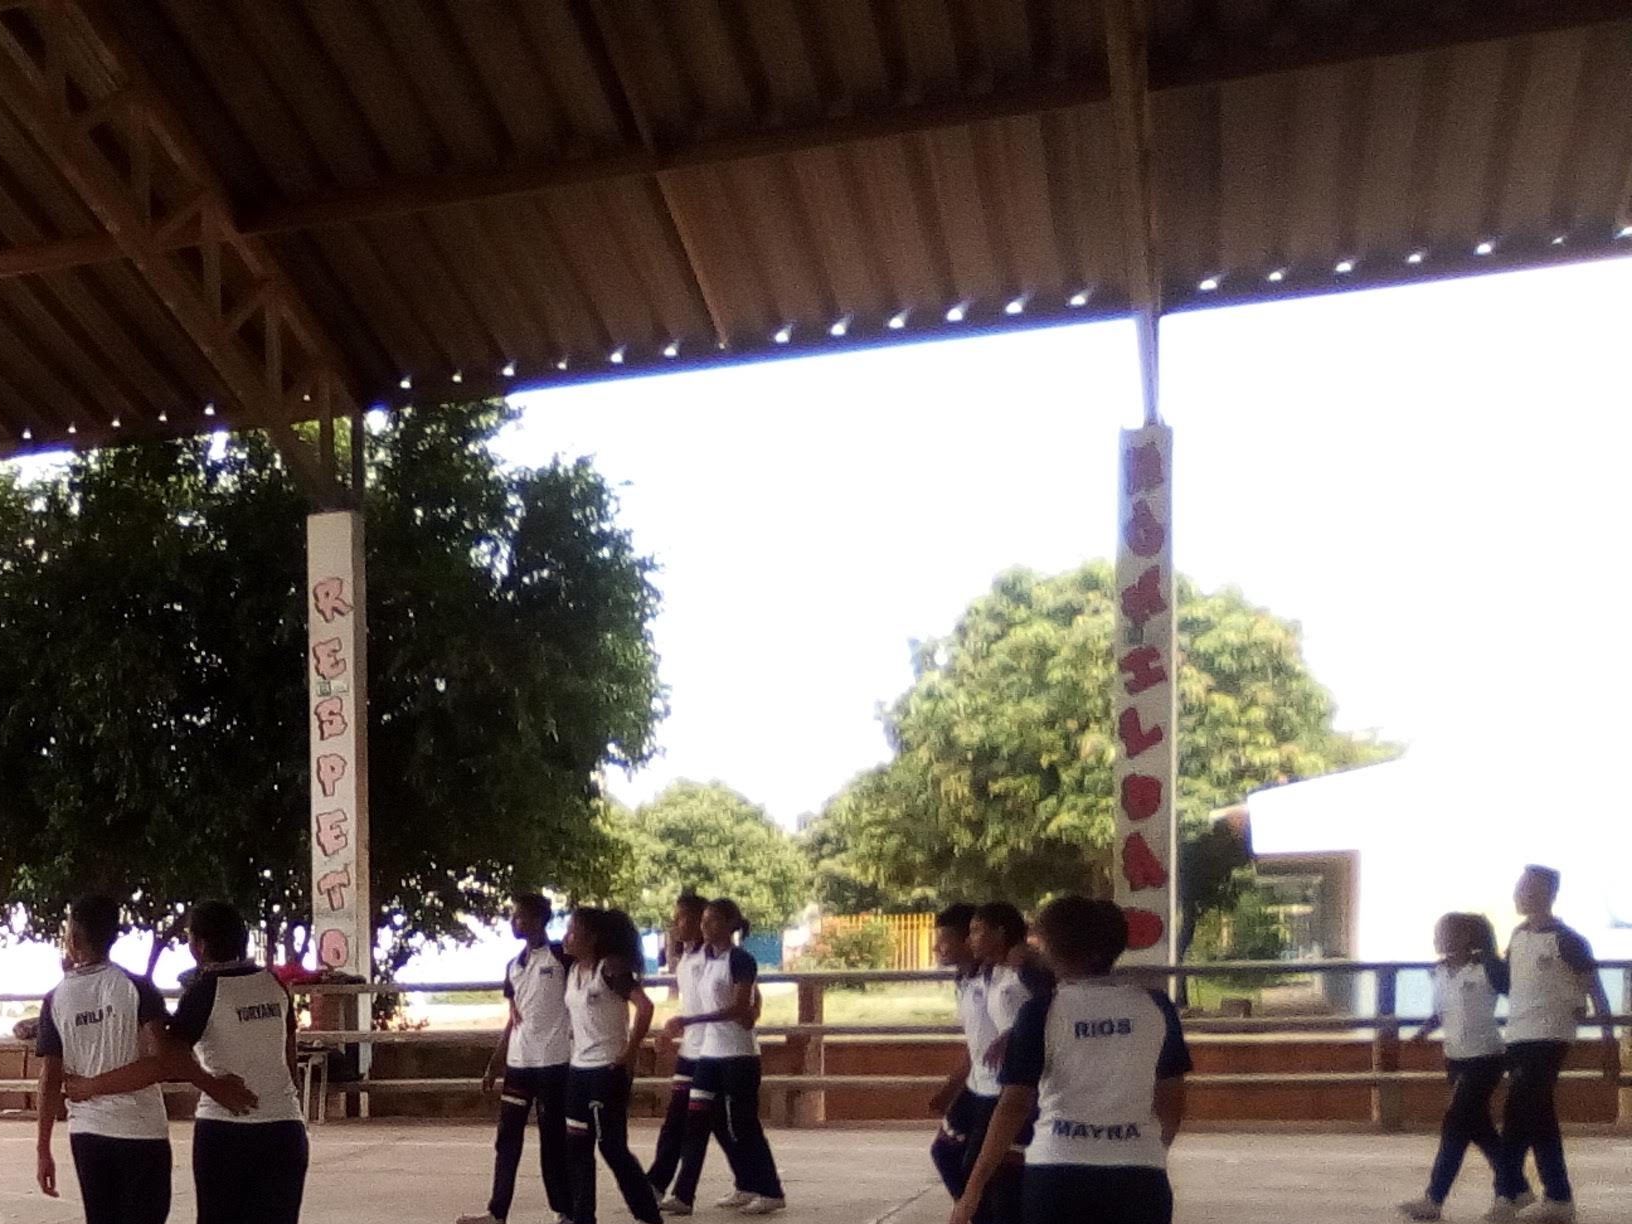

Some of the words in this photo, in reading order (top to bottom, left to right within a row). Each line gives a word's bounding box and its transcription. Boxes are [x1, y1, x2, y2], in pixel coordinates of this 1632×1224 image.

[312, 577, 354, 970] RESPETO
[1074, 1018, 1132, 1040] RIOS
[1053, 1119, 1141, 1141] MAYRA
